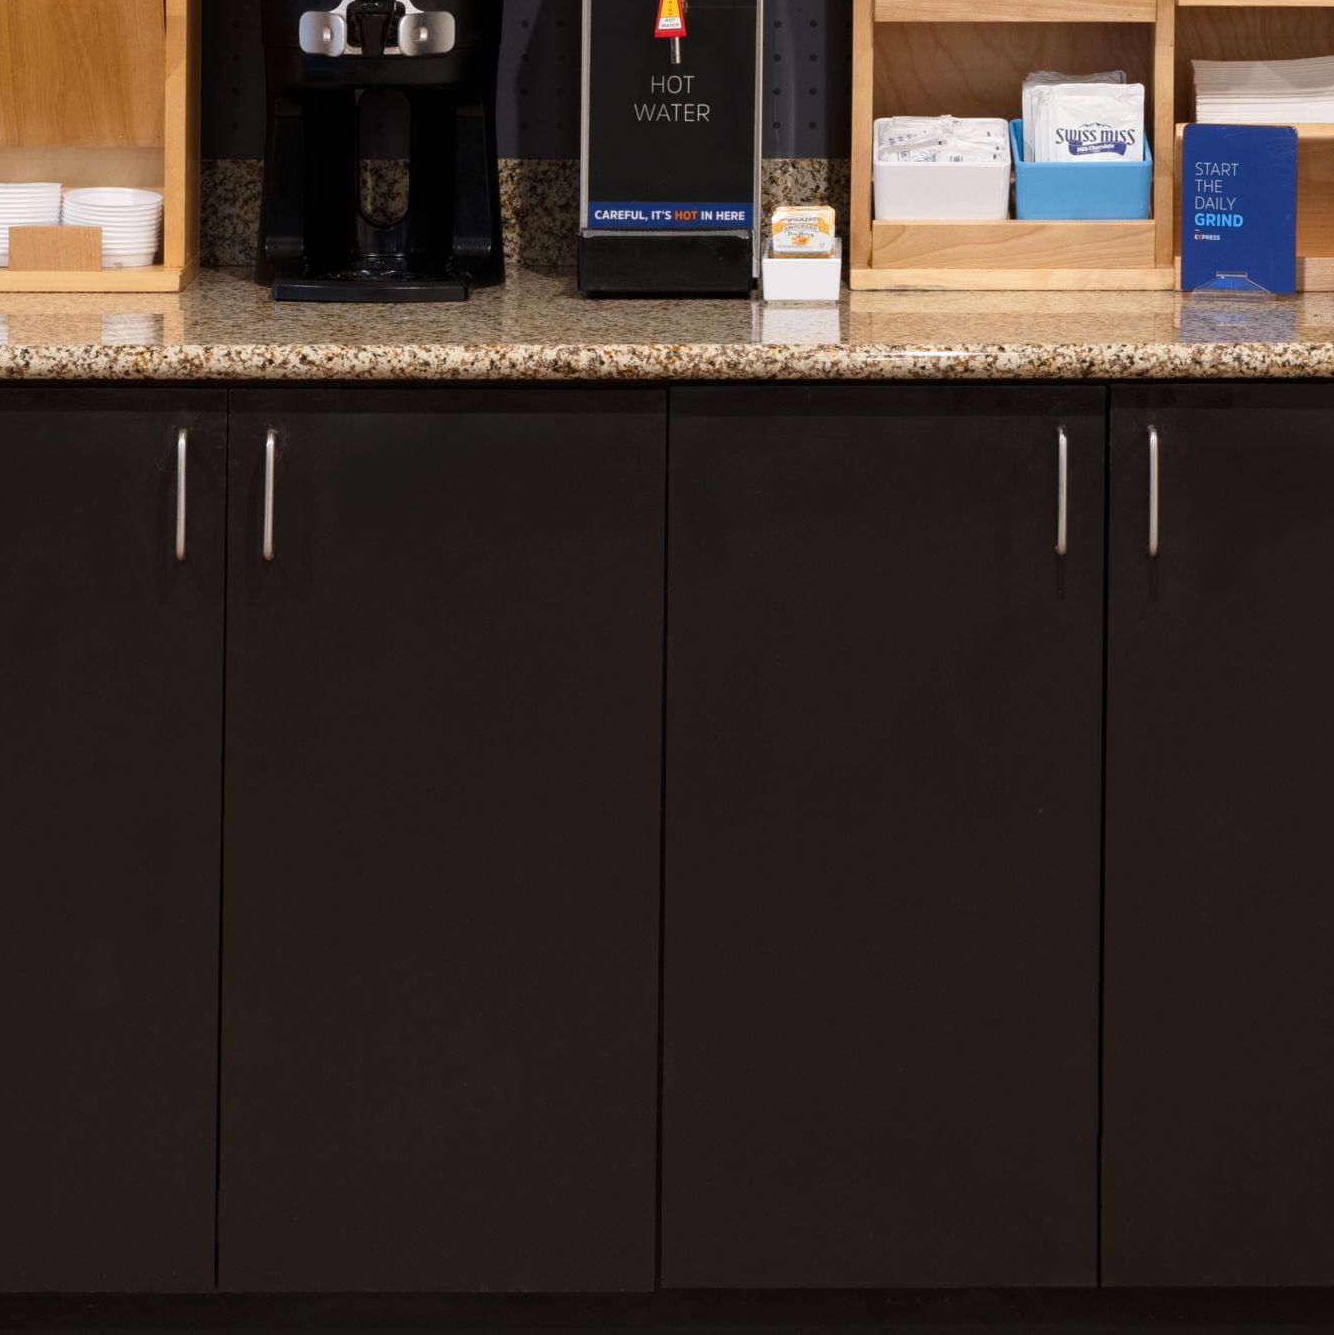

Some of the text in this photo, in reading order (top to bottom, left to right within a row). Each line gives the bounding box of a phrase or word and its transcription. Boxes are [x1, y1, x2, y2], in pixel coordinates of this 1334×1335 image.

[651, 75, 695, 94] HOT
[634, 103, 710, 122] WATER
[1195, 161, 1239, 177] START
[1194, 178, 1223, 193] THE
[1195, 196, 1237, 211] DAILY
[594, 210, 745, 221] CAREFUL, IT'S HOT IN HERE
[1194, 212, 1244, 228] GRIND
